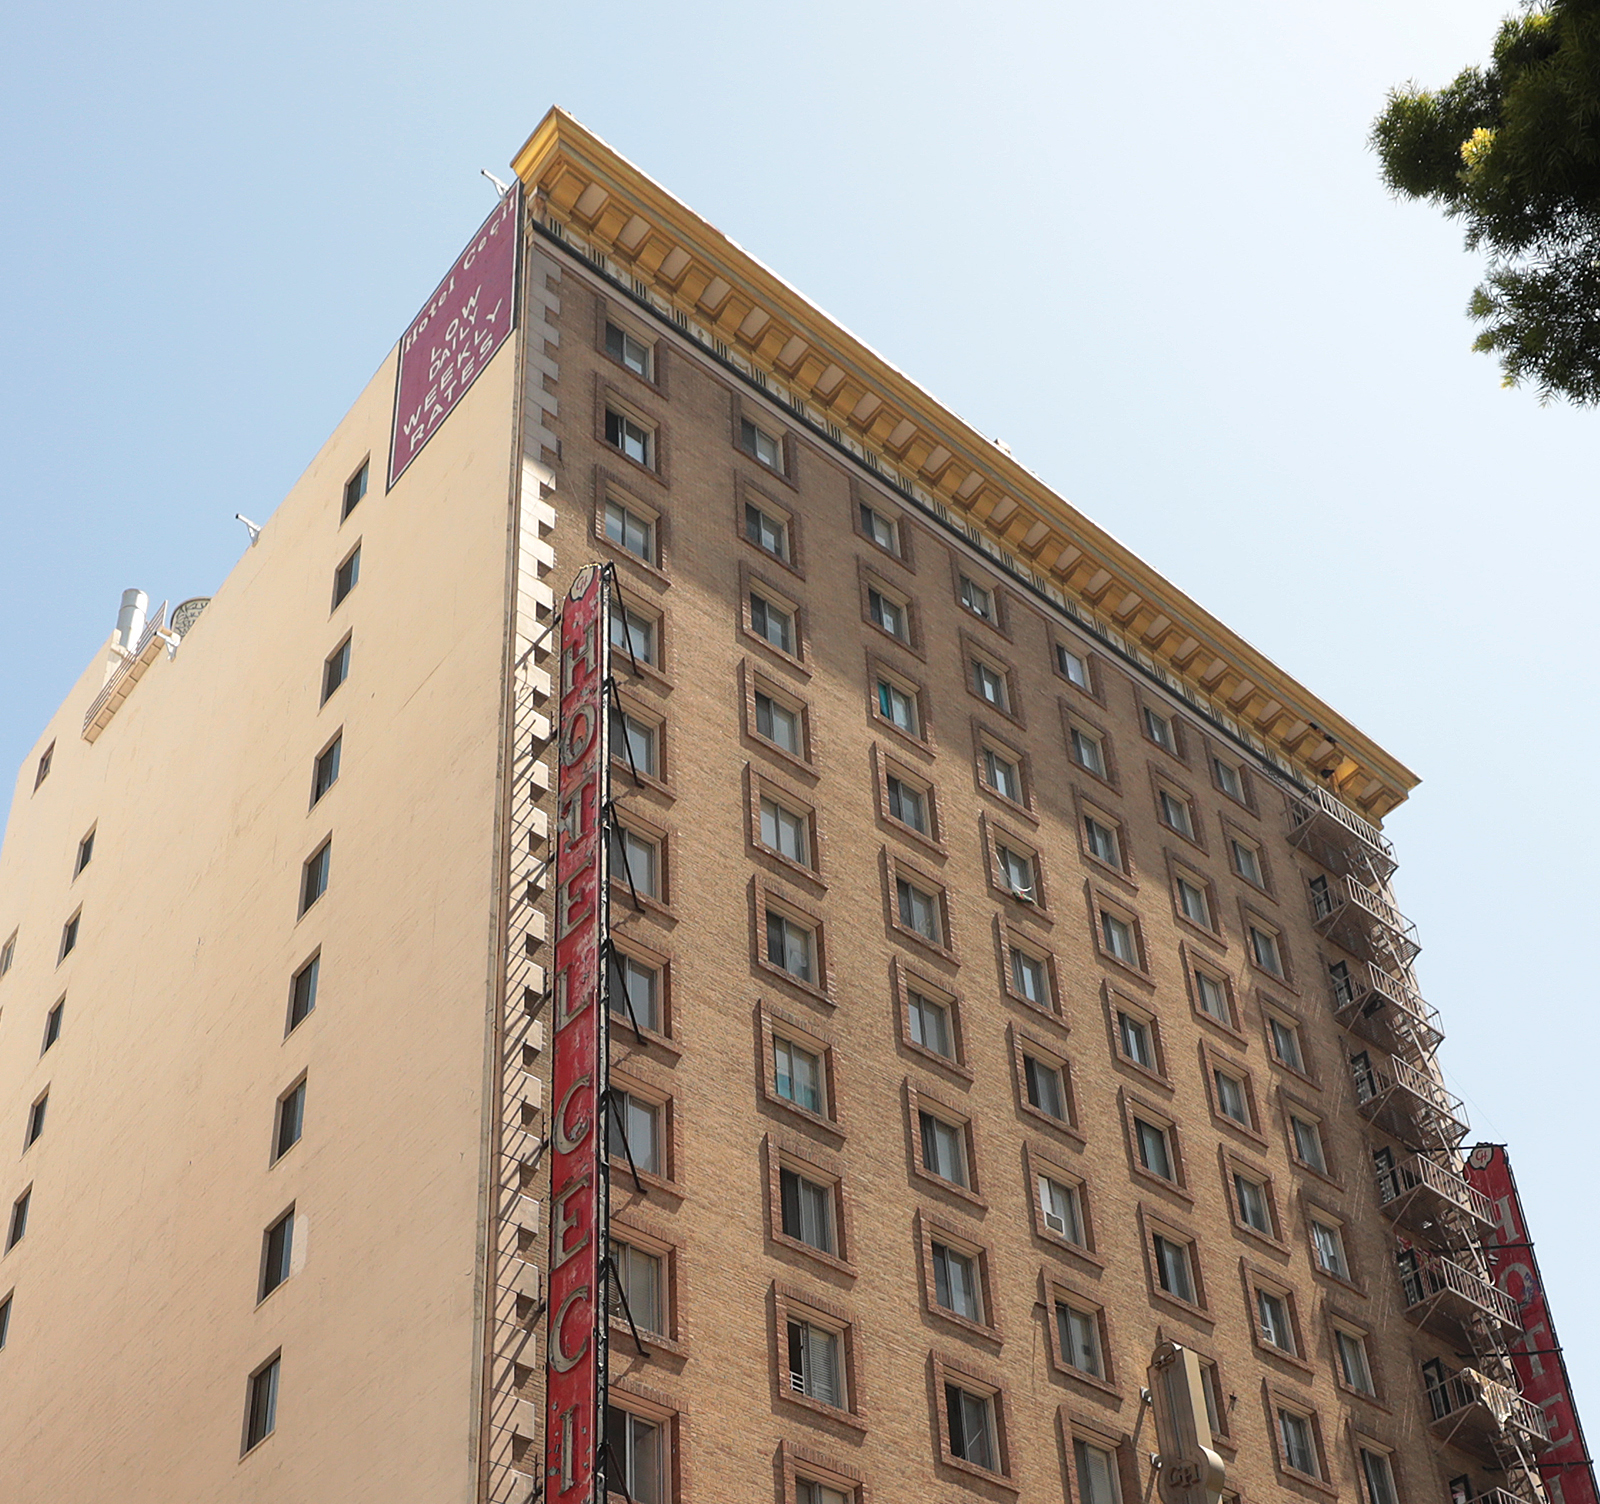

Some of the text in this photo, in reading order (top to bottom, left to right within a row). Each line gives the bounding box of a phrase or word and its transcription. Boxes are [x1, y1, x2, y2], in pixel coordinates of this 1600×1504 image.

[404, 194, 516, 354] Hotel Cecil
[430, 284, 482, 363] LOW
[403, 298, 502, 436] WEEKLY
[409, 338, 494, 452] RATES
[428, 305, 479, 382] DAILY
[555, 621, 597, 1032] HOTEL
